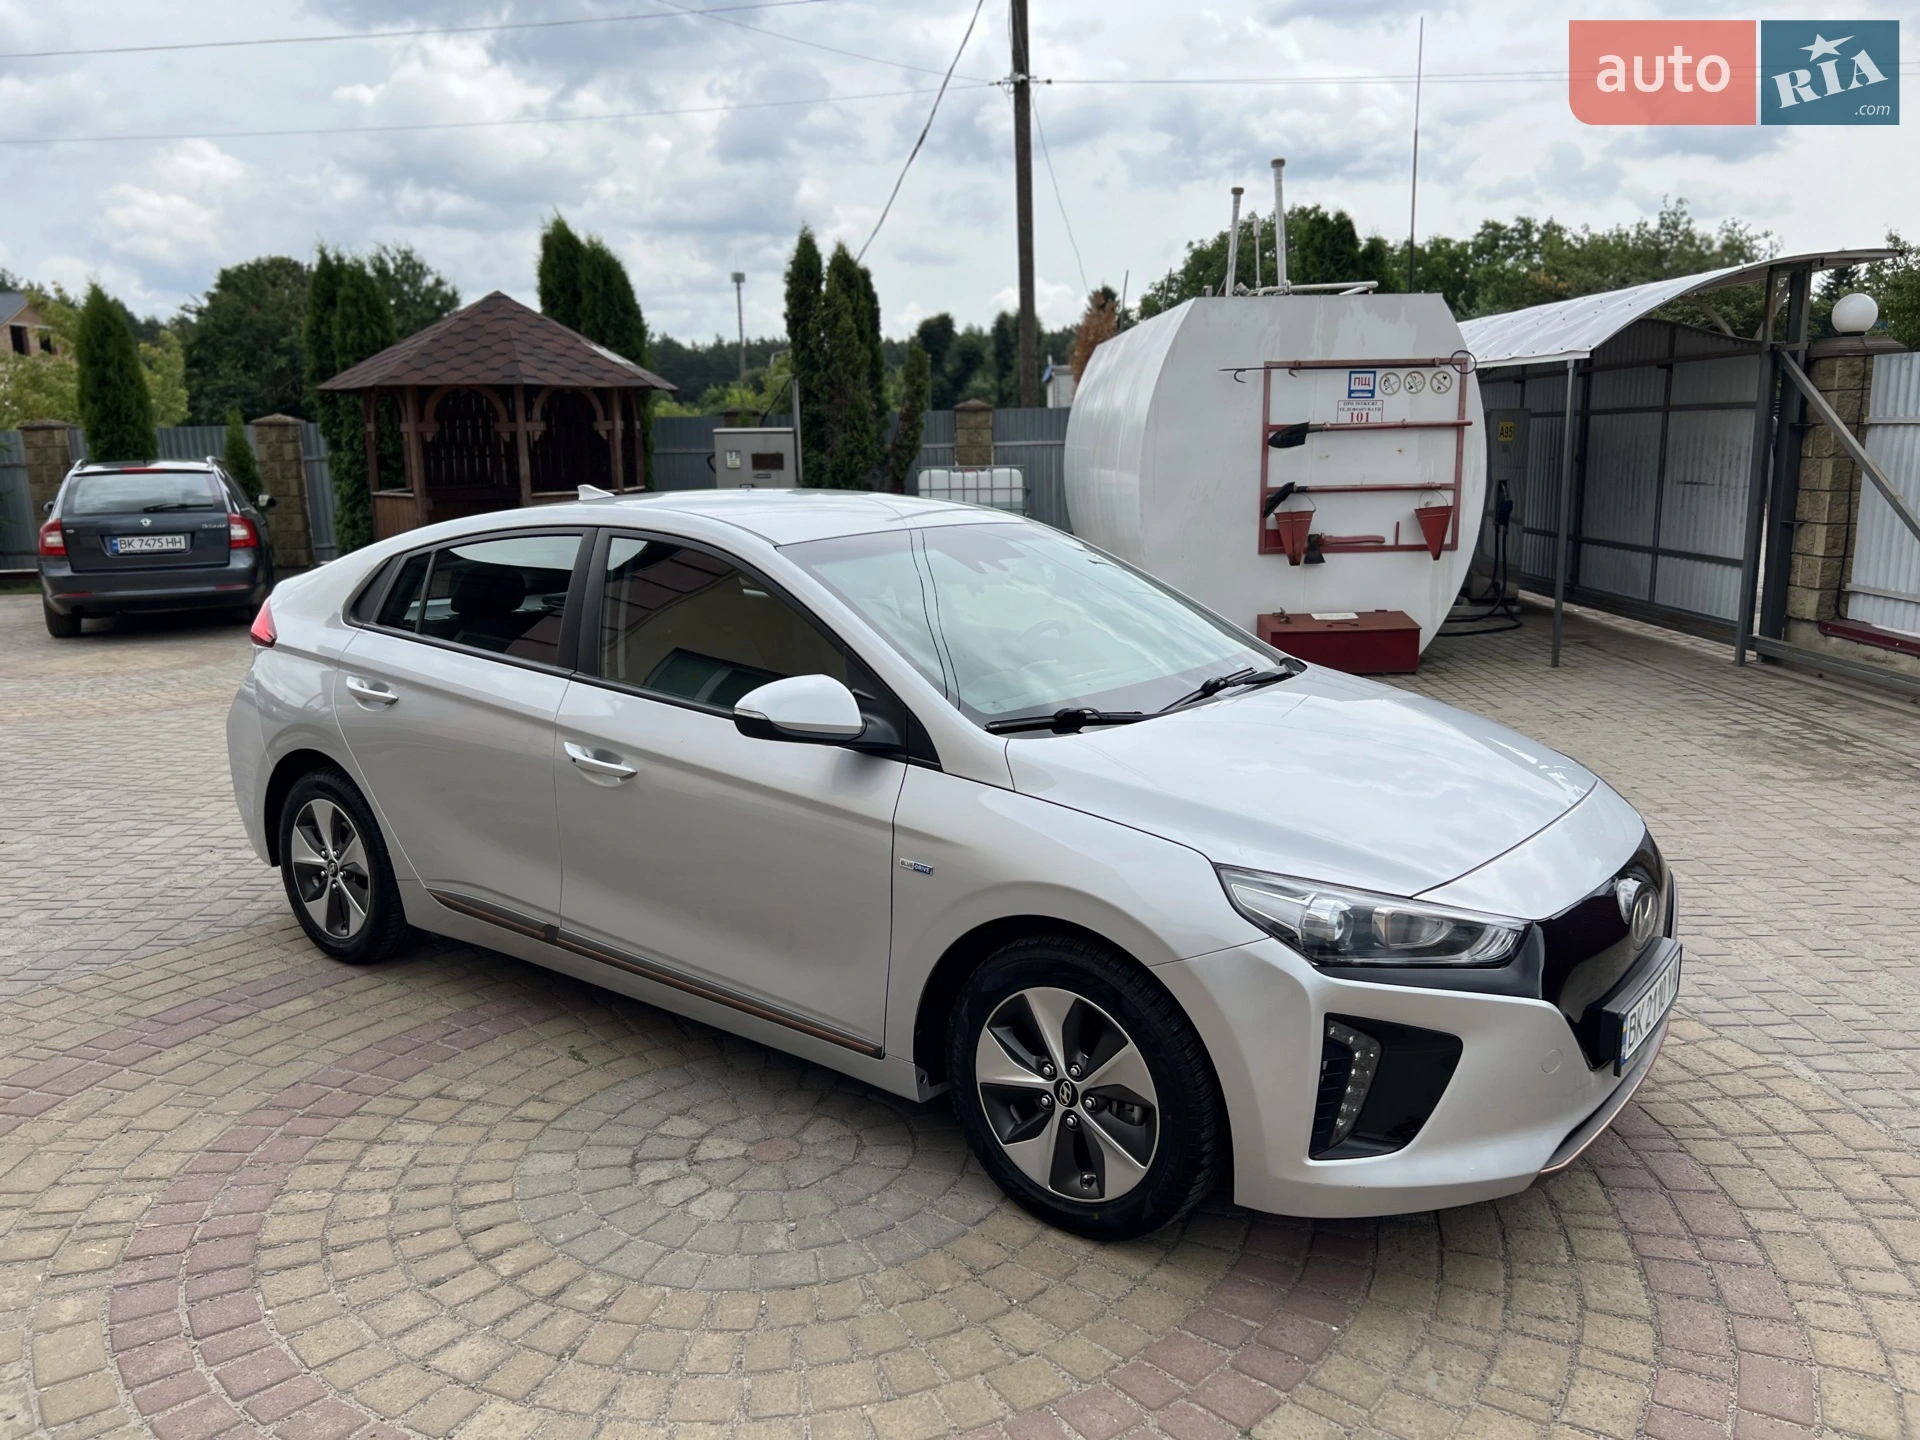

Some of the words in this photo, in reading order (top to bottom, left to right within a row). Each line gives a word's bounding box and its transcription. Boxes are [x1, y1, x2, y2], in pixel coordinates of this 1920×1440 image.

[1353, 377, 1371, 387] ПЩ
[1350, 411, 1370, 423] 101
[1499, 426, 1513, 438] A95
[119, 539, 136, 550] BK
[138, 537, 164, 549] 7475
[166, 537, 182, 547] HH
[1628, 1001, 1645, 1050] BK
